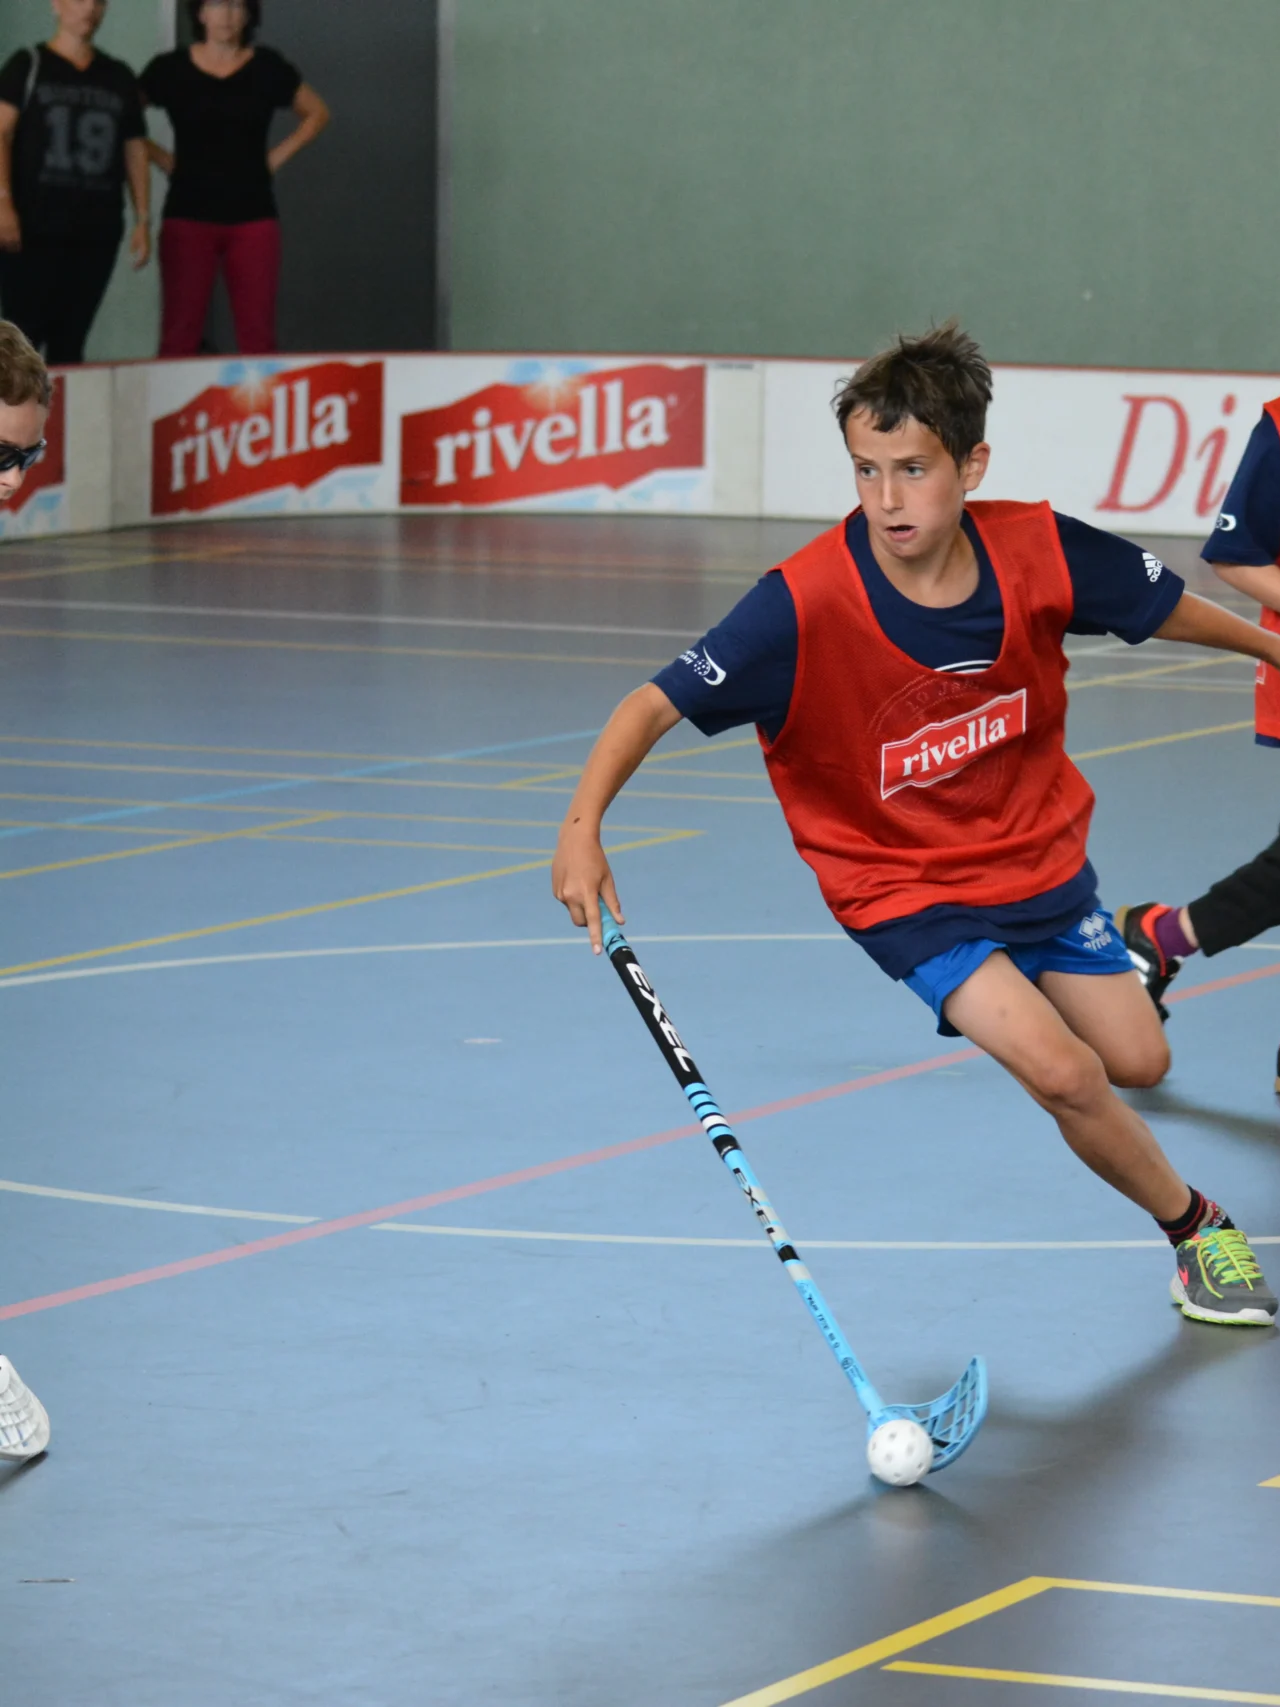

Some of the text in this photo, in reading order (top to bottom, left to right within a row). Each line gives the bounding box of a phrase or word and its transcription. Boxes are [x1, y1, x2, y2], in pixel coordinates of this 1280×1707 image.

[44, 105, 116, 175] 19
[170, 377, 352, 494] rivella
[433, 377, 670, 487] rivella
[1093, 393, 1237, 518] Di
[901, 714, 1008, 777] rivella
[625, 962, 692, 1073] EXEL
[732, 1167, 777, 1244] EXEL
